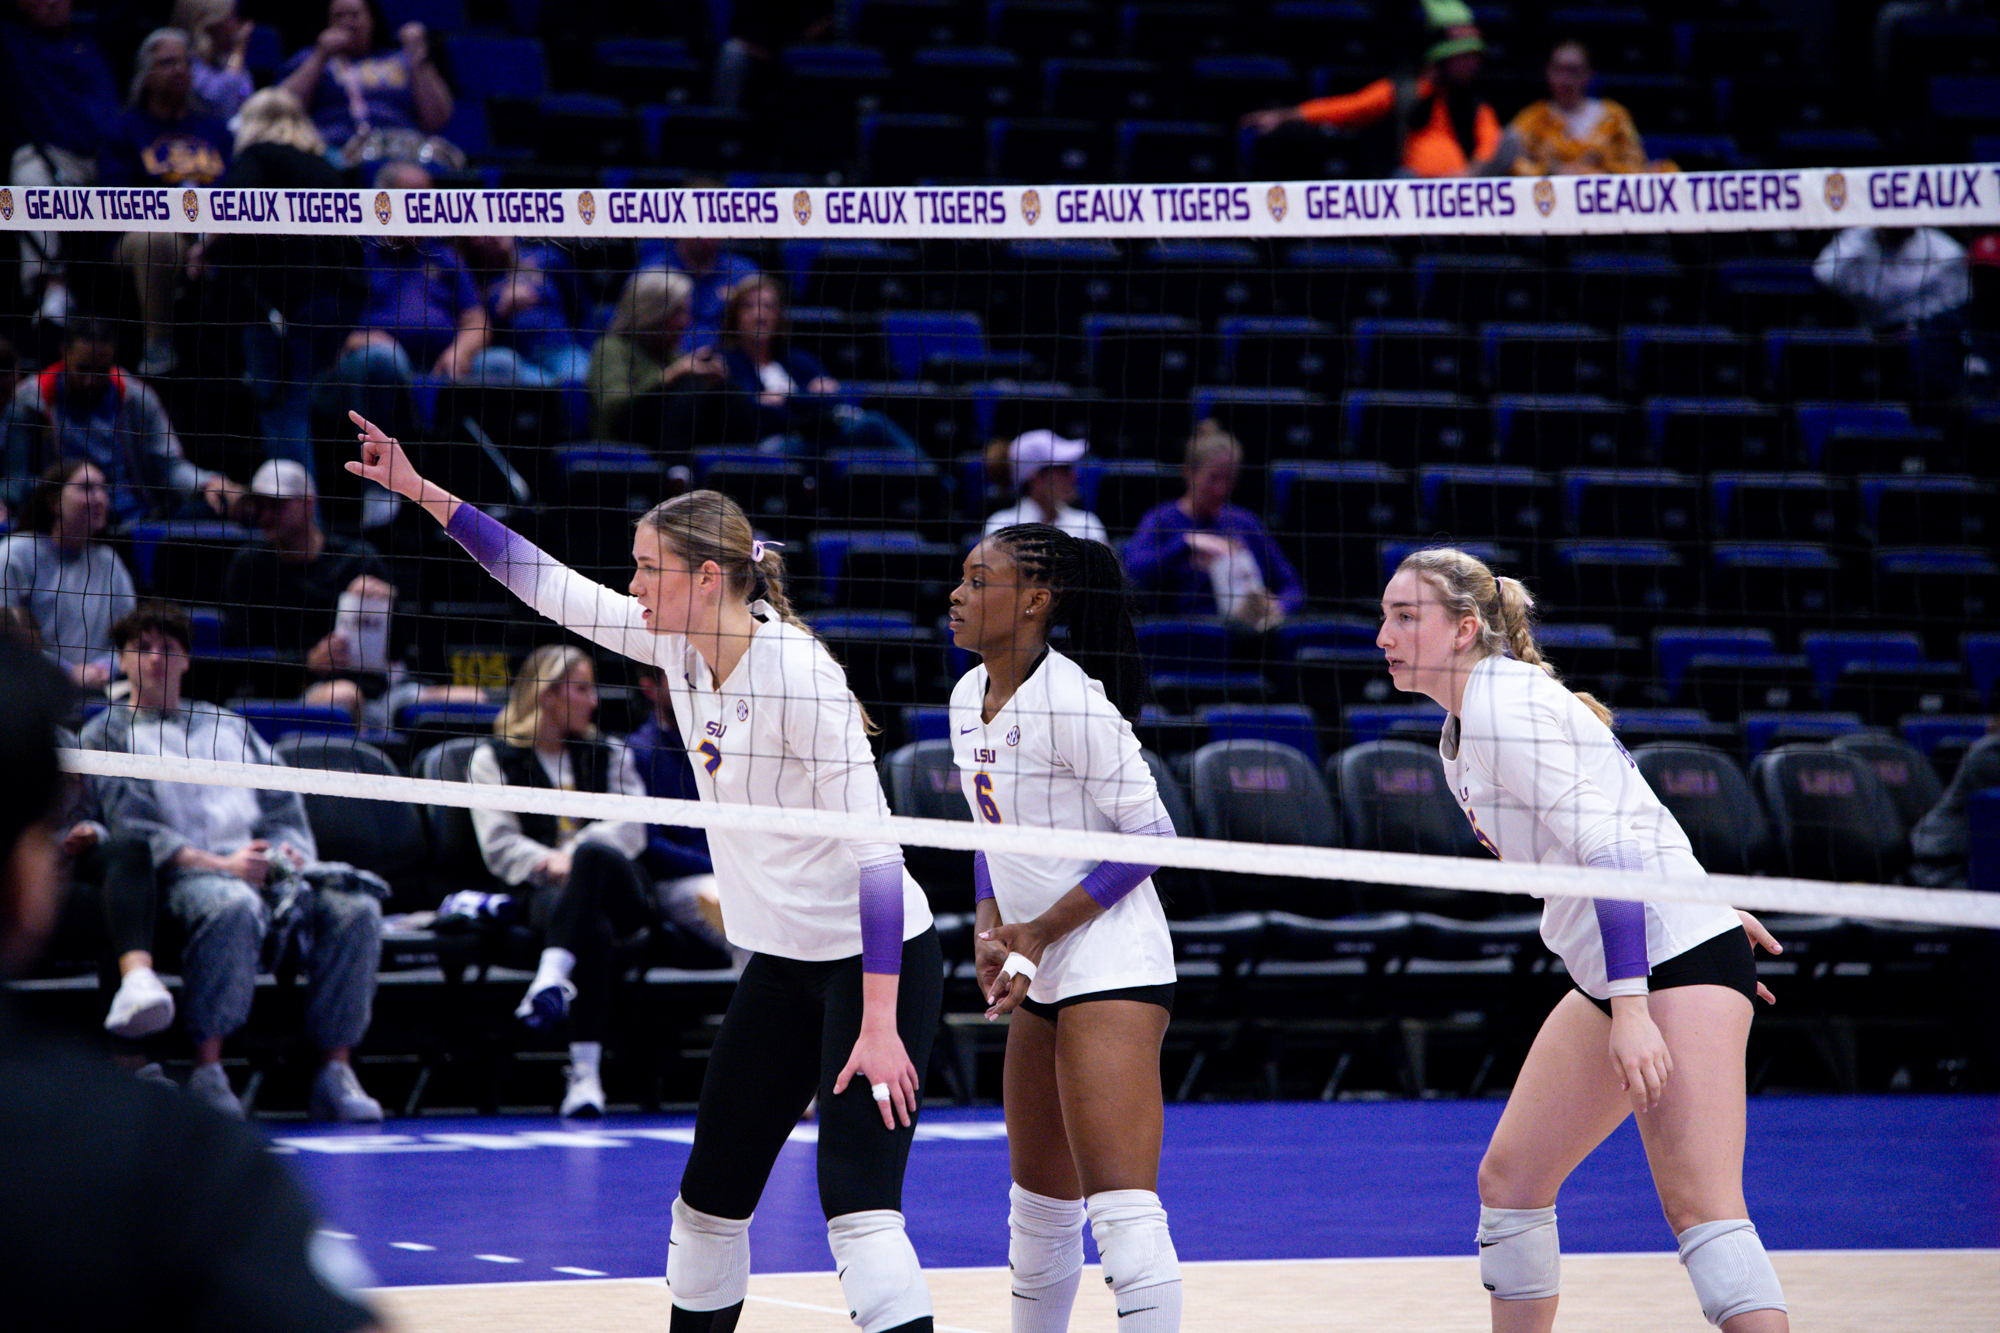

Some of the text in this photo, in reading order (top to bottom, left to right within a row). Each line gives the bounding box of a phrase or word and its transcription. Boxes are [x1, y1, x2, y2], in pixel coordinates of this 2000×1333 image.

[25, 190, 170, 220] GEAUX TIGERS
[1057, 188, 1250, 223] GEAUX TIGERS
[1306, 182, 1515, 219] GEAUX TIGERS
[1576, 175, 1801, 214] GEAUX TIGERS
[1869, 170, 1980, 209] GEAUX
[210, 191, 362, 223] GEAUX TIGERS
[405, 192, 564, 223] GEAUX TIGERS
[609, 192, 778, 223] GEAUX TIGERS
[826, 191, 1006, 224] GEAUX TIGERS
[973, 748, 996, 764] LSU
[973, 771, 1003, 825] 6
